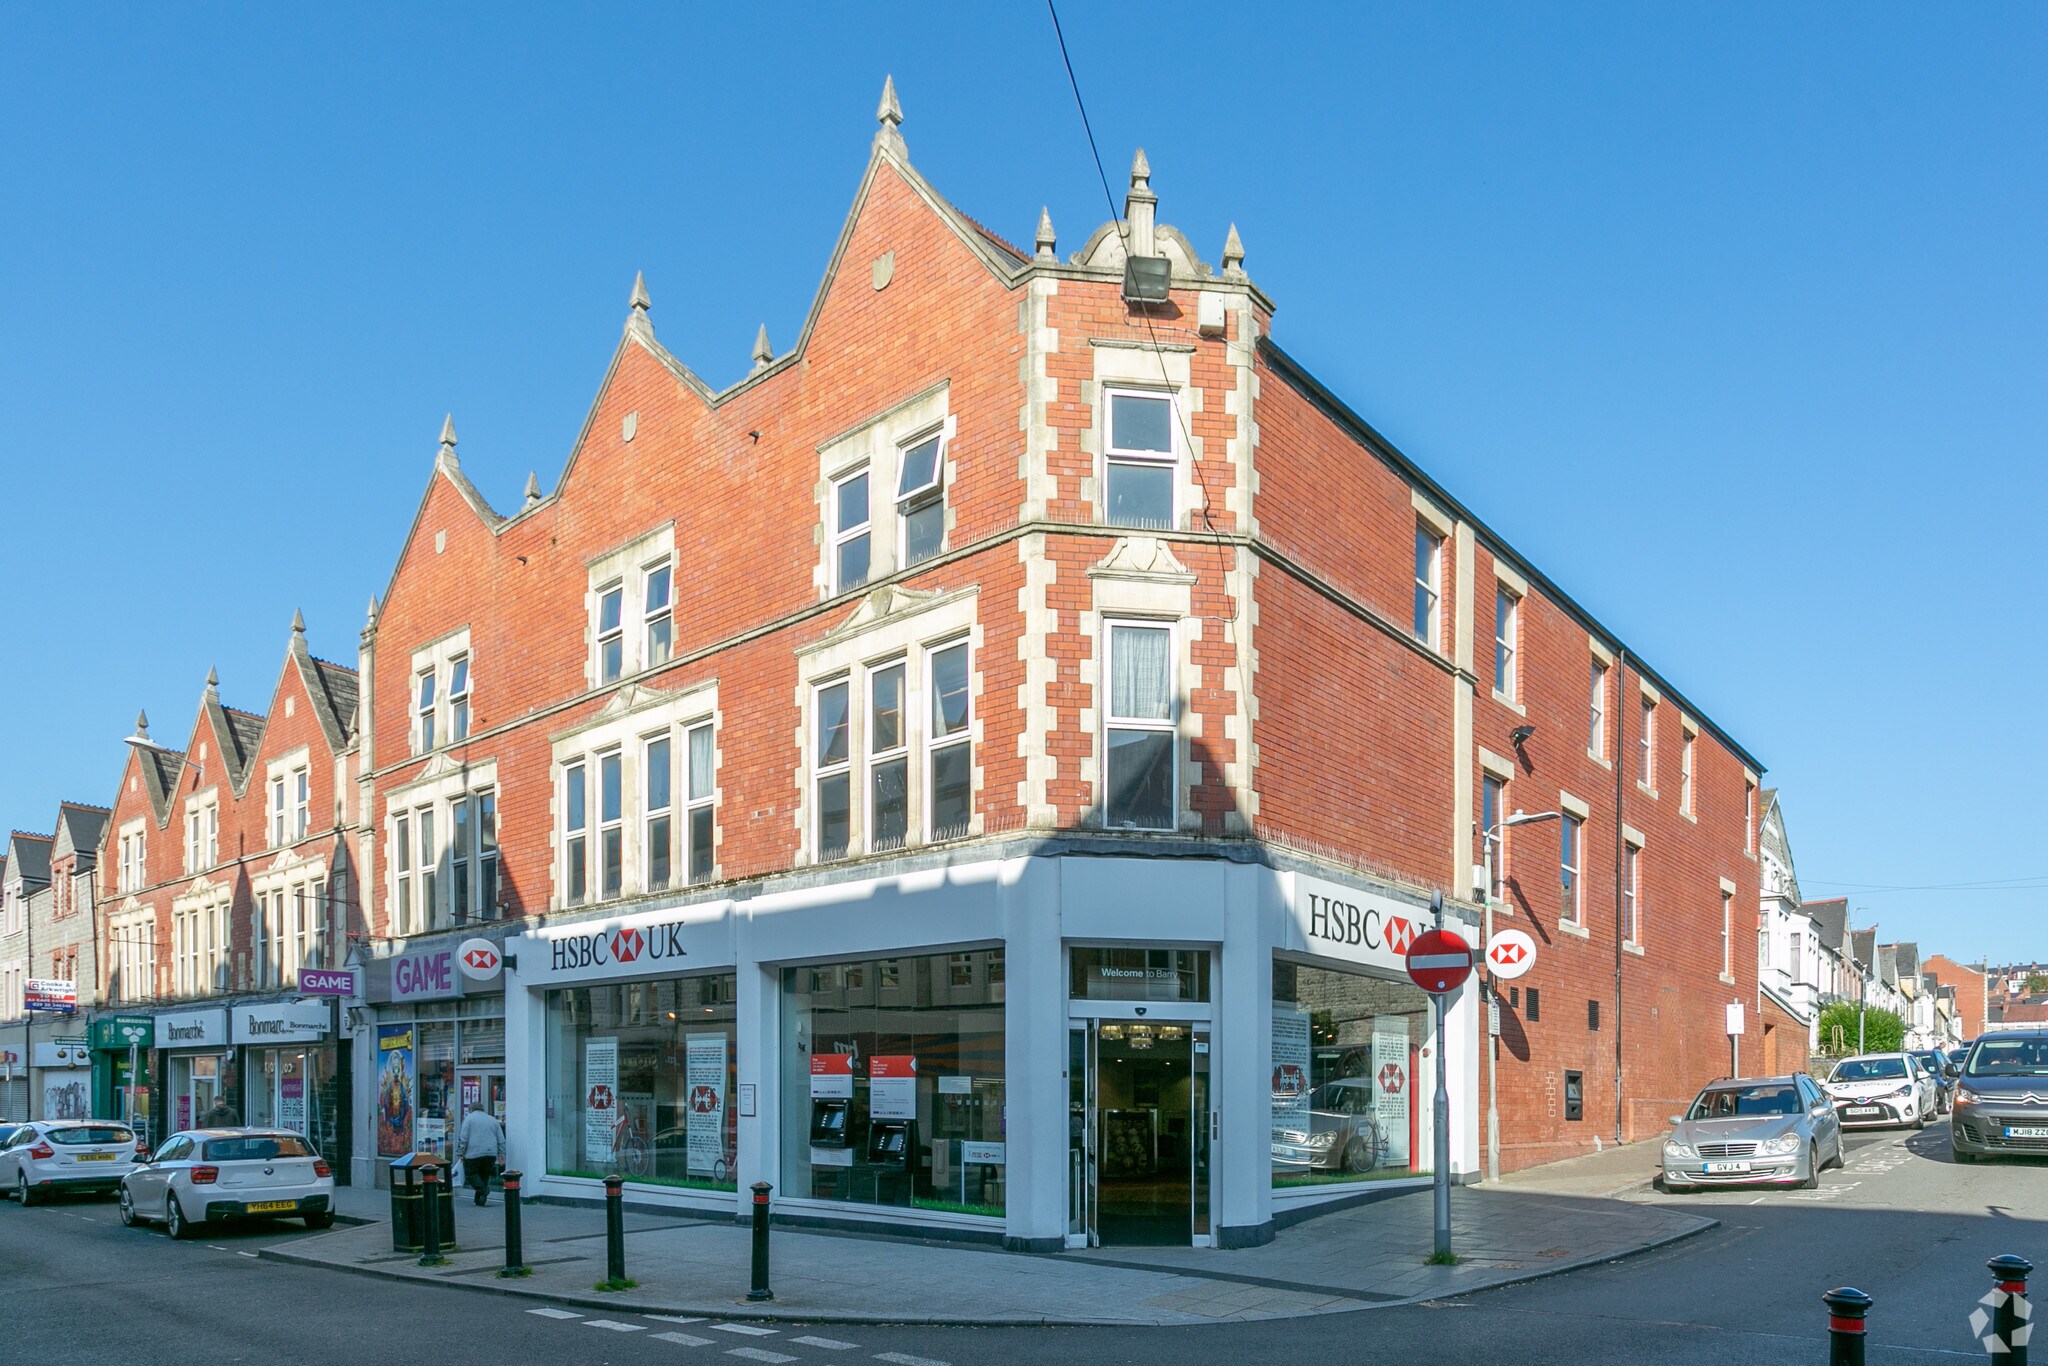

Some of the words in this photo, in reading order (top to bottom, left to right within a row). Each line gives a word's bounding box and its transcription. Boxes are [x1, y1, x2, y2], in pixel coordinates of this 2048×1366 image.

[1308, 893, 1381, 949] HSBC
[551, 931, 608, 970] HSBC
[647, 921, 687, 959] UK
[303, 974, 351, 990] GAME
[396, 952, 451, 994] GAME
[1101, 967, 1144, 978] Welcome
[1146, 969, 1155, 978] to
[1156, 969, 1179, 979] Barry
[249, 1013, 286, 1035] Bonmarc
[290, 1020, 328, 1030] Bonmarché
